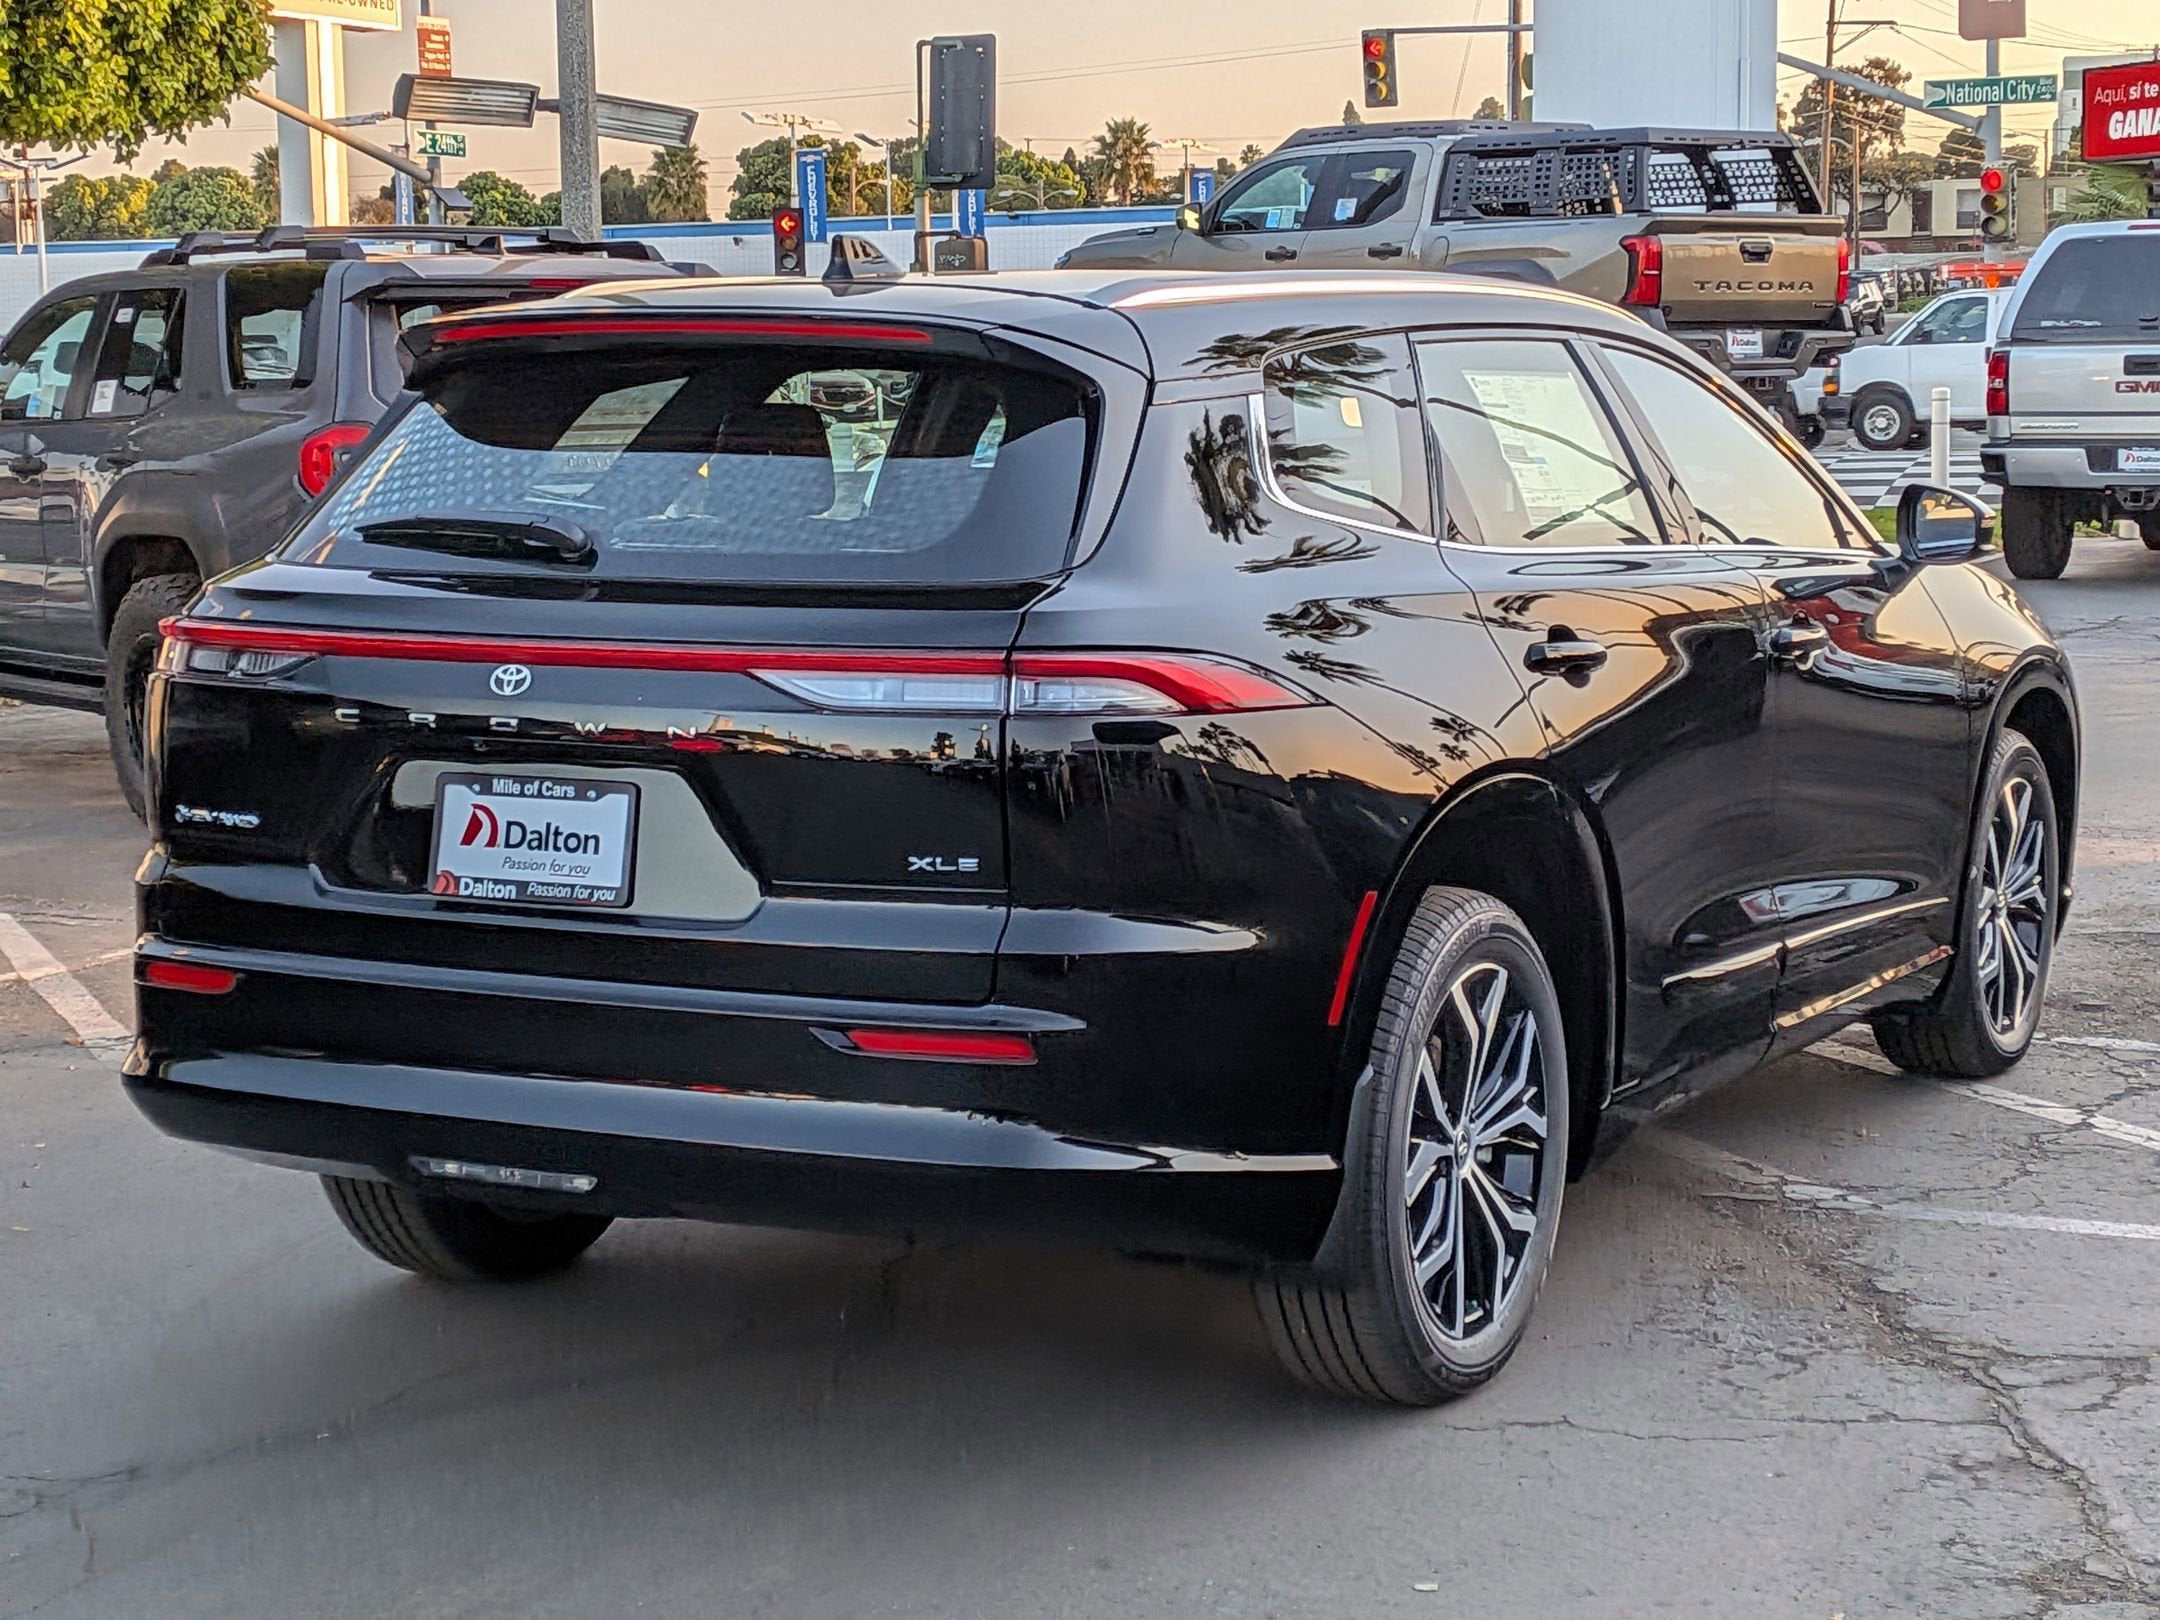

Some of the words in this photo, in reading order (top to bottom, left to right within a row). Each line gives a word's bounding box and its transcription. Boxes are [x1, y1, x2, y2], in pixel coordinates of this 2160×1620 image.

[320, 0, 394, 11] -OWNED
[1946, 80, 2003, 104] National
[2007, 78, 2036, 102] City
[2094, 85, 2127, 105] Aquí,
[2129, 82, 2142, 99] sí
[2144, 81, 2159, 98] te
[425, 132, 435, 153] E
[435, 134, 457, 154] 24th
[806, 165, 819, 241] CHEVROLET
[1693, 280, 1814, 293] TACOMA
[2115, 380, 2160, 394] GM
[2136, 455, 2160, 463] Dalto
[333, 708, 698, 738] CROWN
[491, 778, 521, 795] Mile
[524, 780, 540, 796] of
[541, 781, 576, 798] Cars
[503, 820, 600, 855] Dalton
[501, 856, 546, 872] Passion
[549, 859, 566, 874] for
[567, 863, 591, 875] you
[907, 856, 980, 872] XLE
[459, 877, 517, 899] Dalton
[526, 882, 571, 898] Passion
[572, 885, 592, 900] for
[590, 888, 616, 902] you
